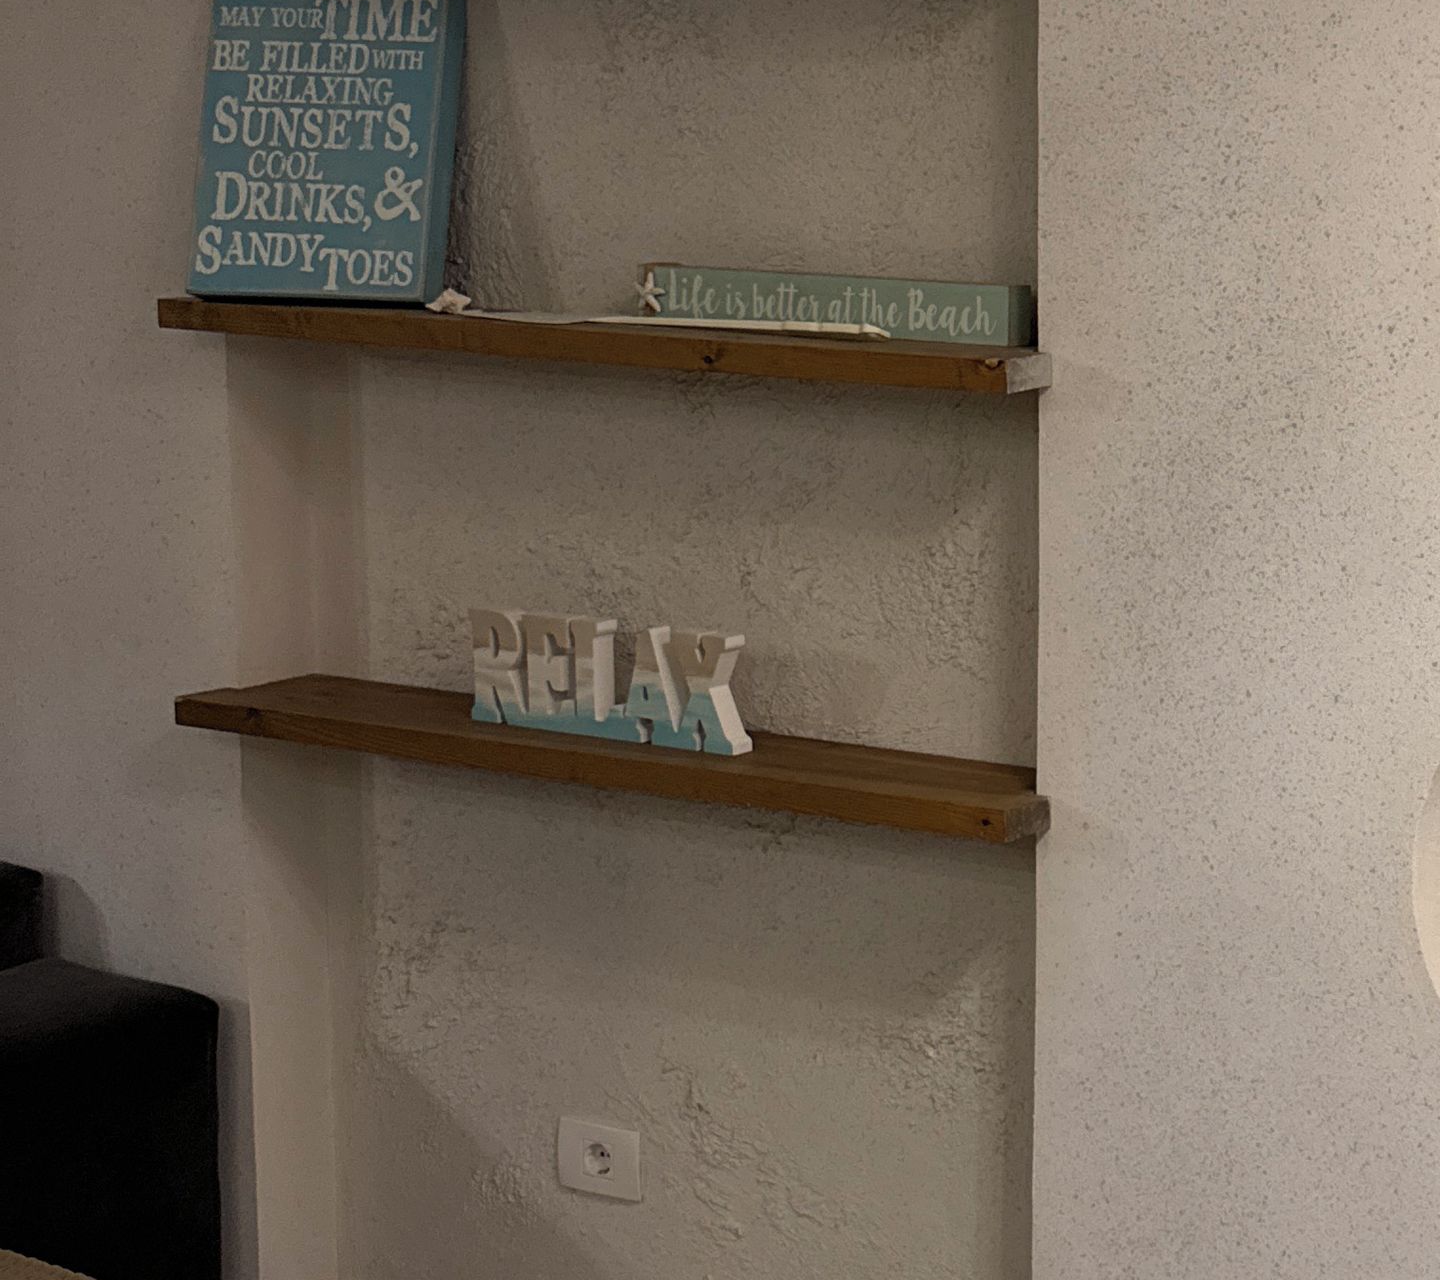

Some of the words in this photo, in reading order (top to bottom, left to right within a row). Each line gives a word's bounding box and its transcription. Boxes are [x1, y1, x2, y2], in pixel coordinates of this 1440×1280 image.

[220, 6, 266, 28] MAY
[271, 7, 324, 29] YOUR
[211, 40, 250, 71] BE
[259, 41, 370, 74] FILLED
[372, 49, 424, 71] WITH
[245, 74, 395, 105] RELAXING
[212, 96, 419, 158] SUNSETS,
[248, 150, 323, 180] COOL
[210, 171, 372, 232] DRINKS,
[374, 166, 423, 221] &
[195, 225, 325, 275] SANDY
[318, 247, 414, 291] TOES
[667, 269, 720, 318] Life
[725, 283, 746, 319] is
[752, 282, 820, 322] better
[828, 286, 854, 324] at
[859, 287, 903, 328] the
[907, 287, 996, 336] Beach
[468, 608, 753, 755] RELAX
